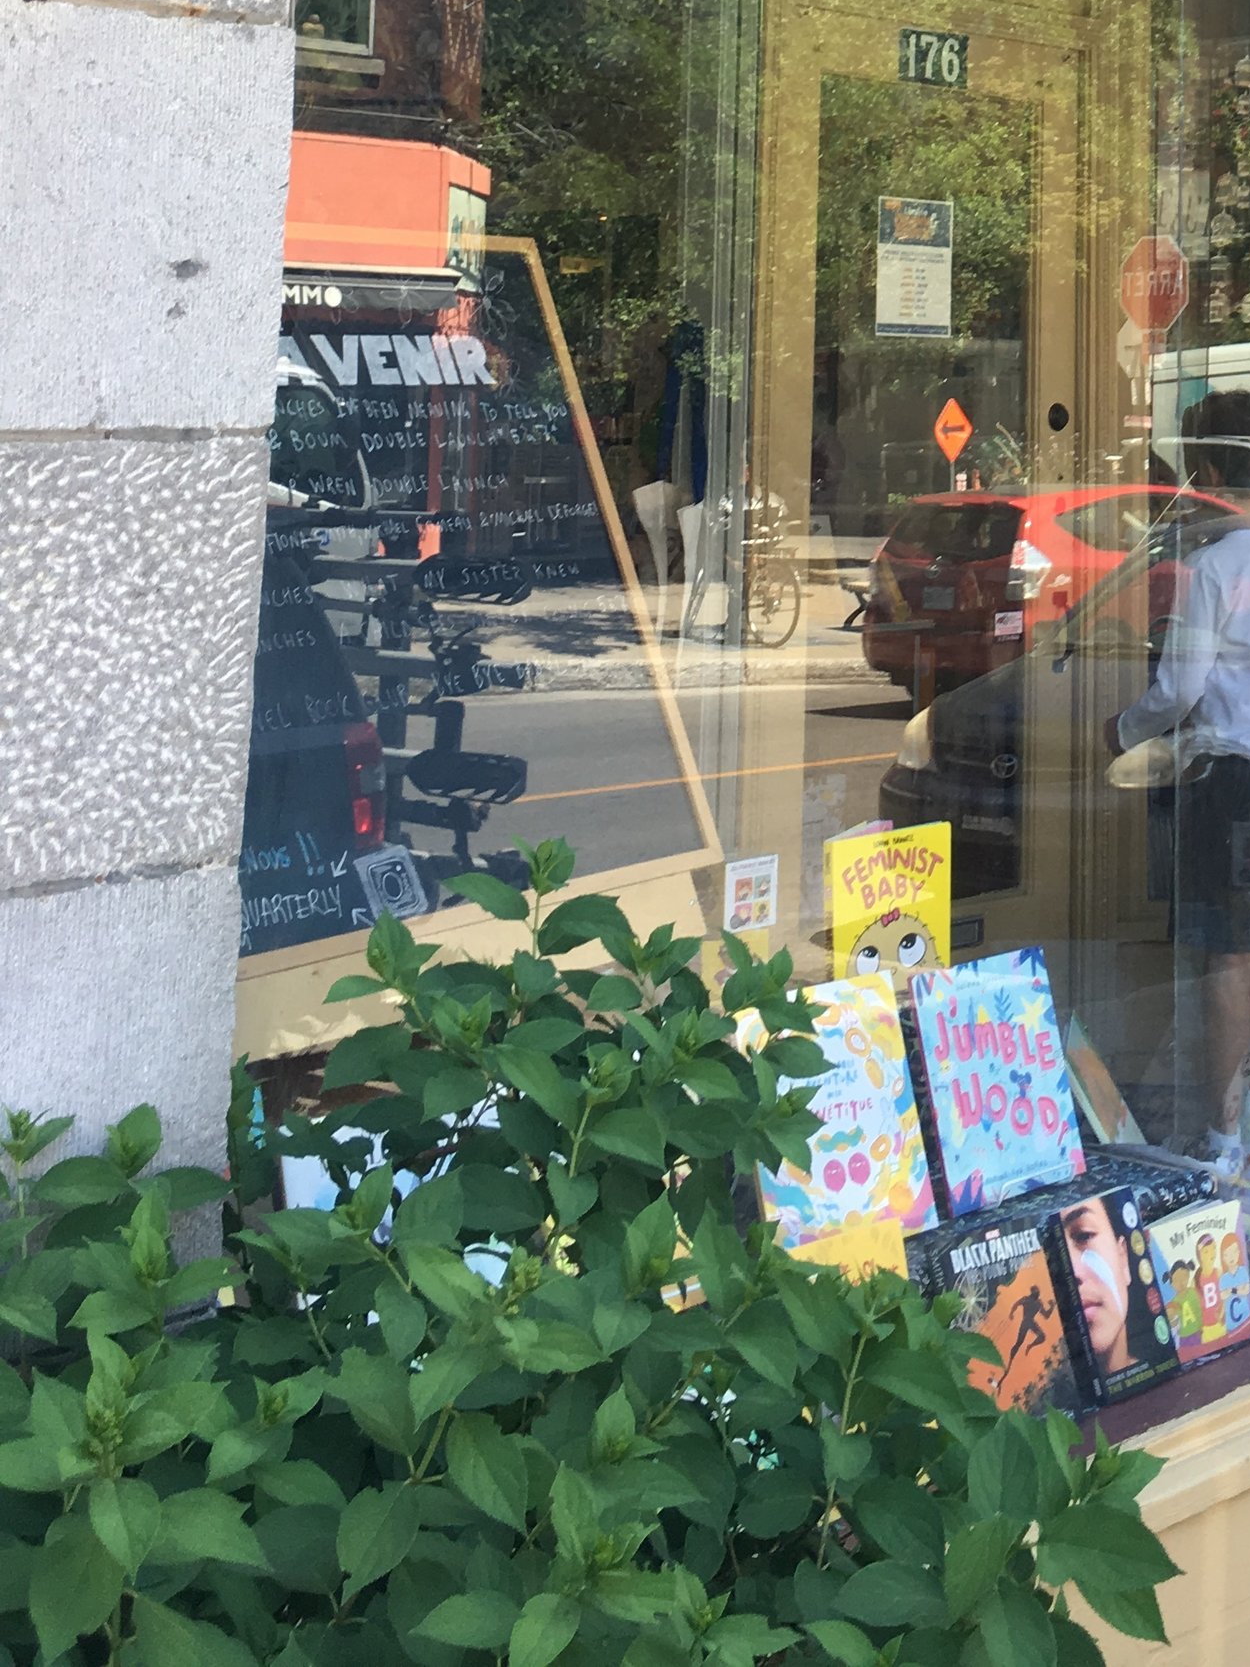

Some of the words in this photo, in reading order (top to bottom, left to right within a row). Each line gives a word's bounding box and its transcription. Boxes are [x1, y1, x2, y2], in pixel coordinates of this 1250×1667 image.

[906, 33, 961, 84] 176
[360, 430, 427, 454] DOUBLE
[841, 845, 945, 895] FEMINIST
[860, 873, 926, 911] BABY
[934, 1011, 1057, 1073] JUMBLE
[951, 1072, 1061, 1138] WOOD
[1186, 1215, 1227, 1237] Feminist
[1202, 1282, 1219, 1309] B
[1229, 1297, 1244, 1323] C
